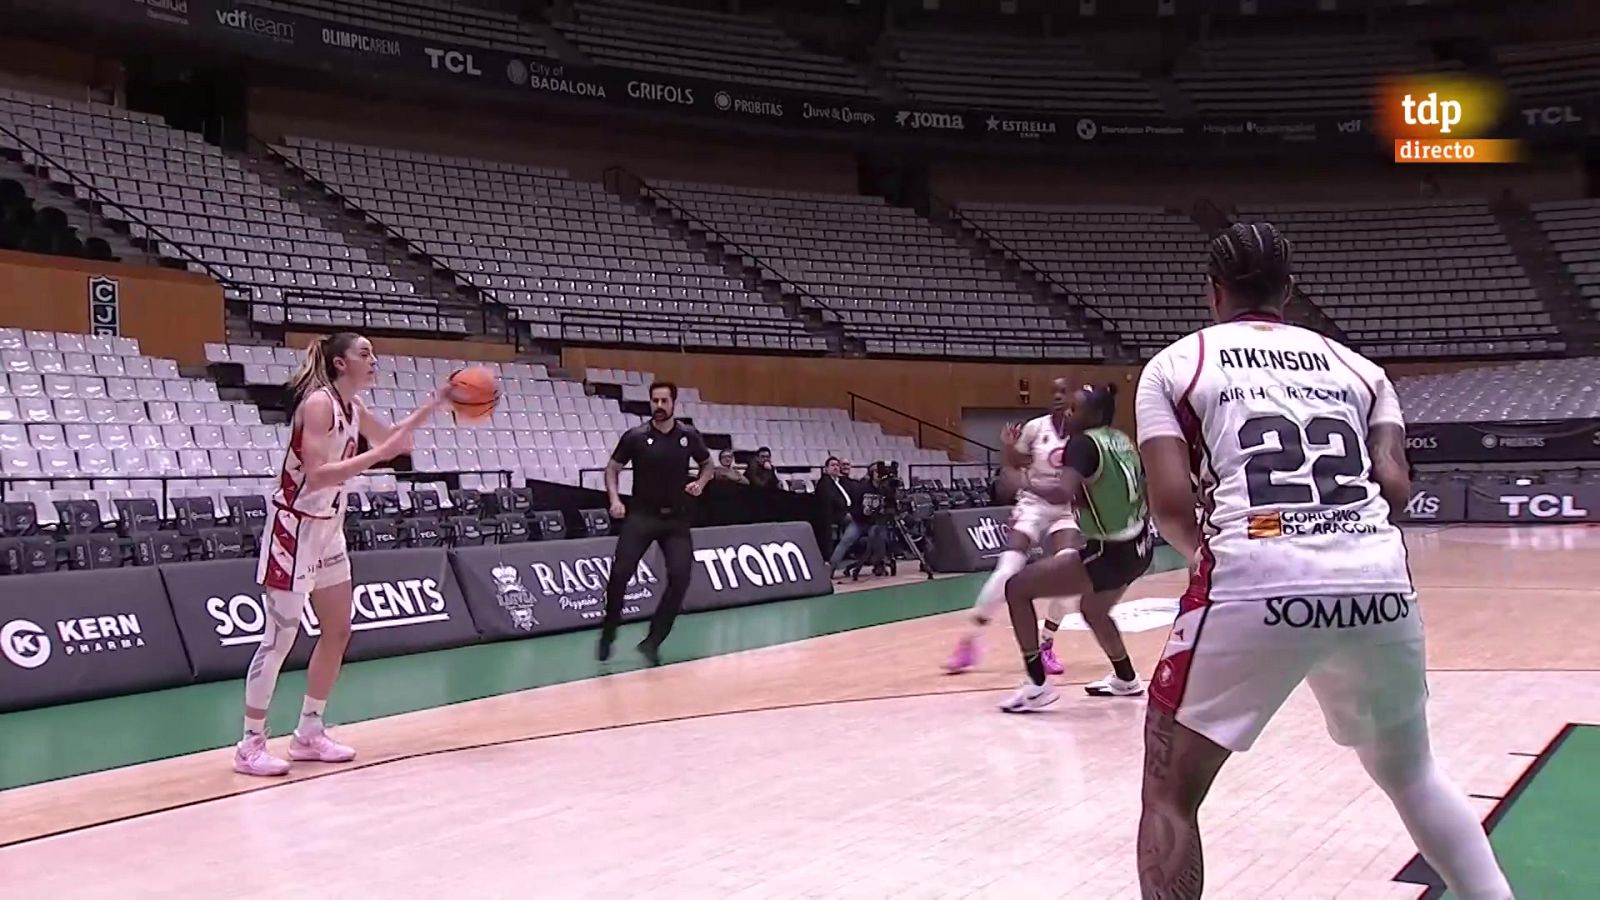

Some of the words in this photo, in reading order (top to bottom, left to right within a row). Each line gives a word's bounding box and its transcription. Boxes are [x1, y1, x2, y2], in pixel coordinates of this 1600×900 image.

[424, 47, 482, 76] TCL
[531, 75, 607, 98] BADALONA
[627, 81, 694, 105] GRIFOLS
[734, 99, 783, 117] PROBITAS
[1520, 106, 1582, 125] TCL
[1002, 120, 1056, 133] ESTRELLA
[1219, 347, 1330, 371] ATKINSON
[1219, 386, 1246, 405] AIR
[1237, 414, 1368, 507] 22
[245, 509, 266, 517] TCL
[1499, 494, 1589, 518] TCL
[376, 534, 396, 542] TCL
[420, 531, 438, 539] TCL
[1281, 523, 1307, 535] DE
[1264, 593, 1409, 629] SOMMOS
[57, 615, 141, 642] KERN
[65, 637, 145, 656] PHARMA
